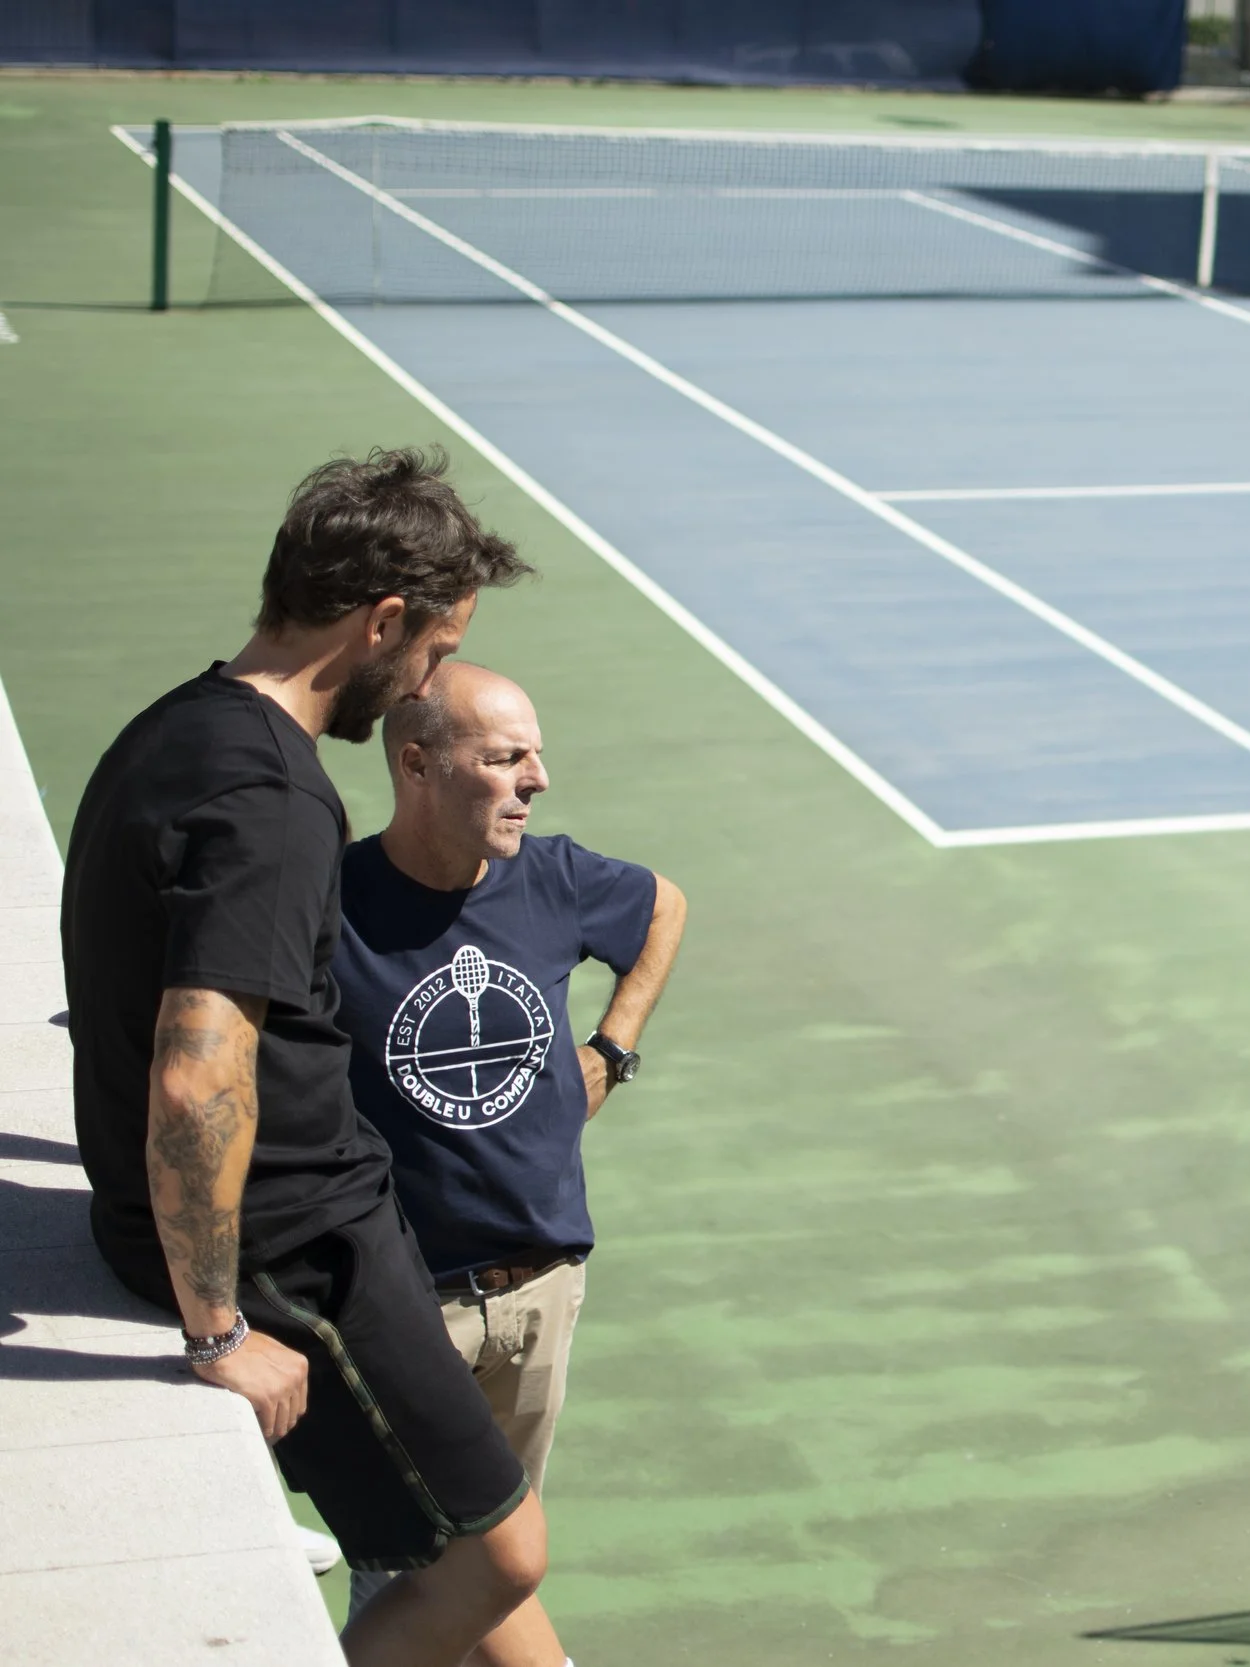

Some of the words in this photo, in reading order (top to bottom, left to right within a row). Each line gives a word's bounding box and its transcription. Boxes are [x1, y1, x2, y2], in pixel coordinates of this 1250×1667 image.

[397, 1013, 415, 1046] EST
[414, 977, 447, 1010] 2012
[497, 971, 545, 1027] ITALIA
[481, 1044, 544, 1116] COMPANY
